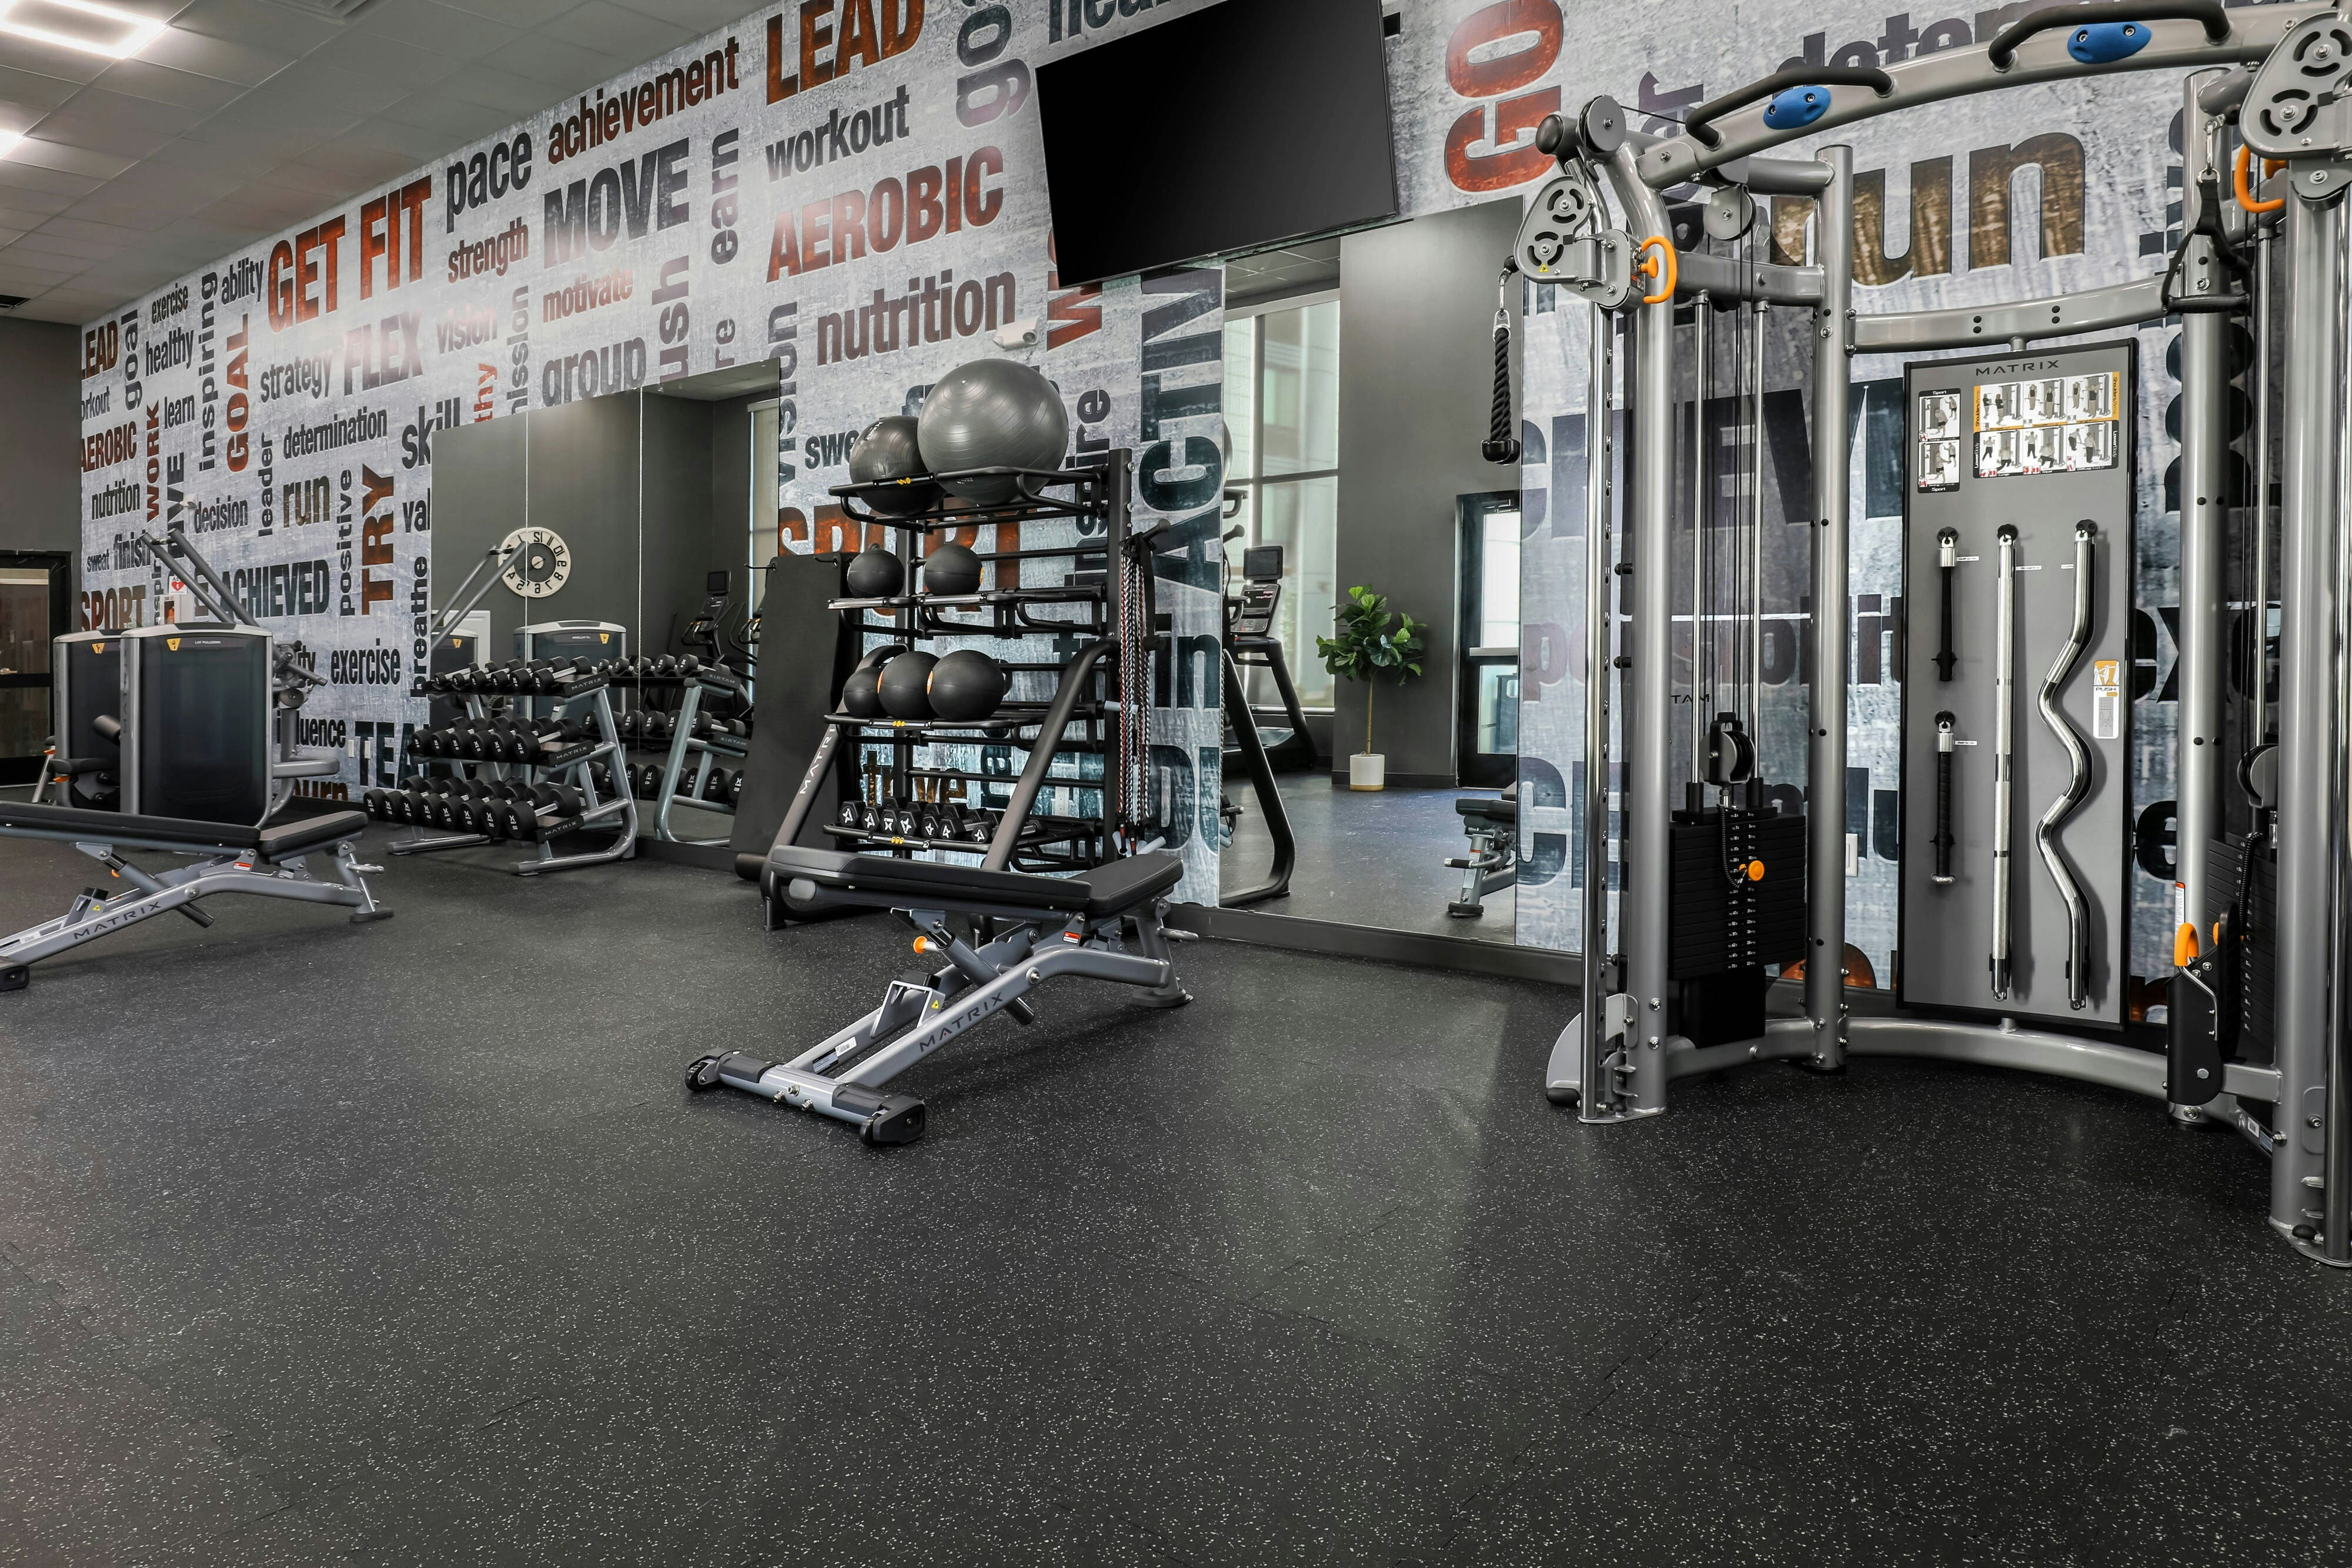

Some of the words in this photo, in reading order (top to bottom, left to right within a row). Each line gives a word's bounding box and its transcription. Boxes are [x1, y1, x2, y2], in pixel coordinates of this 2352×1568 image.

[766, 0, 925, 106] LEAD
[956, 0, 1031, 128] go
[548, 36, 739, 165] achievement
[1445, 0, 1564, 192] GO
[766, 85, 910, 182] workout
[447, 132, 532, 233] pace
[544, 137, 689, 269] MOVE
[711, 128, 739, 265] earn
[766, 146, 1004, 283] AEROBIC
[268, 213, 345, 333] GET
[360, 175, 431, 301] FIT
[448, 216, 529, 283] strength
[152, 283, 188, 325] exercise
[222, 257, 264, 305] ability
[543, 266, 633, 323] motivate
[436, 304, 497, 355] vision
[817, 268, 1016, 366] nutrition
[81, 320, 118, 380] EAD
[121, 309, 142, 411] goal
[146, 327, 194, 376] healthy
[199, 272, 218, 472] inspiring
[260, 353, 332, 403] strategy
[344, 310, 423, 396] FLEX
[542, 337, 646, 407] group
[1975, 359, 2060, 376] MATRIX
[81, 386, 110, 422] orkout
[164, 394, 195, 429] learn
[227, 313, 248, 473] GOAL
[81, 421, 137, 473] AEROBIC
[283, 406, 387, 459] determination
[805, 430, 859, 469] swe
[1139, 266, 1223, 595] ACTIV
[147, 400, 159, 523] WORK
[258, 432, 273, 536] leader
[92, 479, 140, 520] nutrition
[194, 495, 248, 534] decision
[283, 475, 330, 529] run
[87, 549, 110, 573] sweat
[113, 530, 151, 570] finish
[336, 469, 356, 616] positive
[362, 463, 394, 616] TRY
[81, 584, 146, 631] SPORT
[220, 559, 329, 619] ACHIEVED
[410, 556, 428, 698] breathe
[330, 638, 400, 684] exercise
[572, 677, 602, 690] MATRIX
[556, 745, 587, 759] MATRIX
[799, 728, 836, 794] MATRI
[544, 821, 577, 836] MATRIX
[73, 901, 162, 941] MATRIX
[918, 992, 1004, 1052] MATRIX
